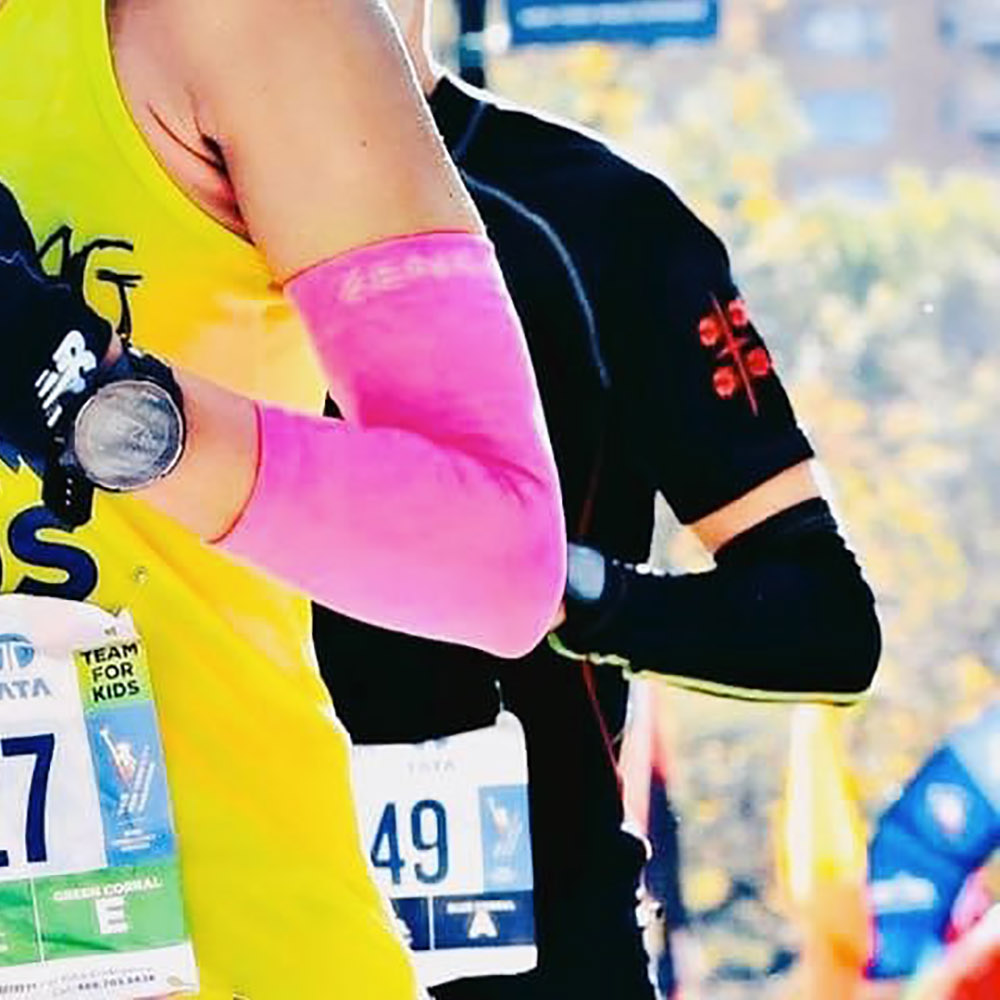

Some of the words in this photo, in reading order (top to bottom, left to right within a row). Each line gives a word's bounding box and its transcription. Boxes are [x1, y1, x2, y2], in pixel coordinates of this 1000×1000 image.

[80, 642, 138, 666] TEAM
[91, 661, 134, 683] FOR
[91, 680, 140, 703] KIDS
[370, 799, 449, 885] 49
[96, 897, 128, 935] E
[469, 908, 498, 938] A
